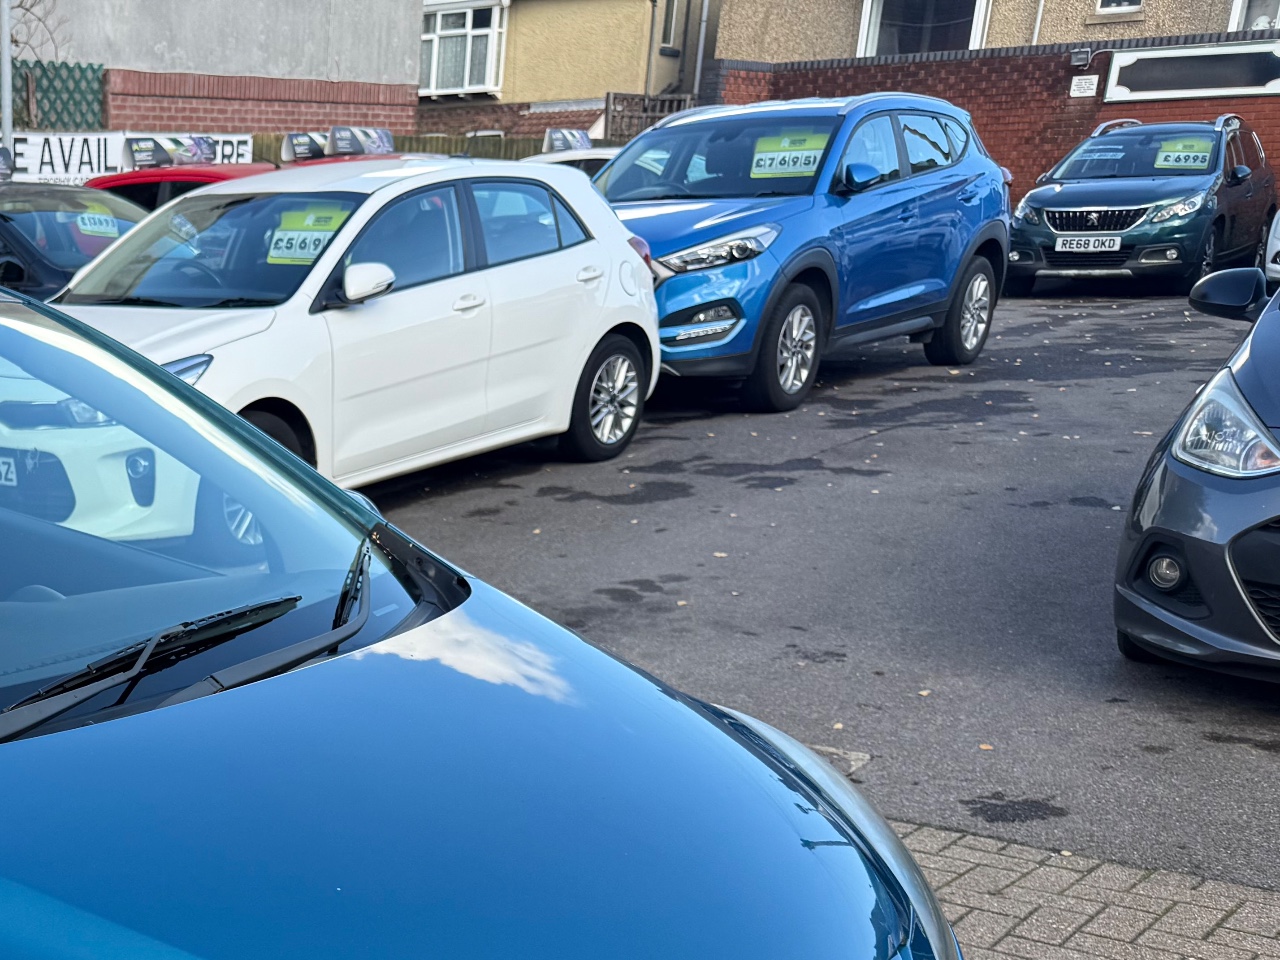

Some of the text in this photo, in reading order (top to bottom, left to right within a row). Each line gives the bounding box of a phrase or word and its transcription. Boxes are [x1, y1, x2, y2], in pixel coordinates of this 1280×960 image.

[39, 137, 122, 174] AVAIL
[1061, 238, 1115, 249] RE68 OKD
